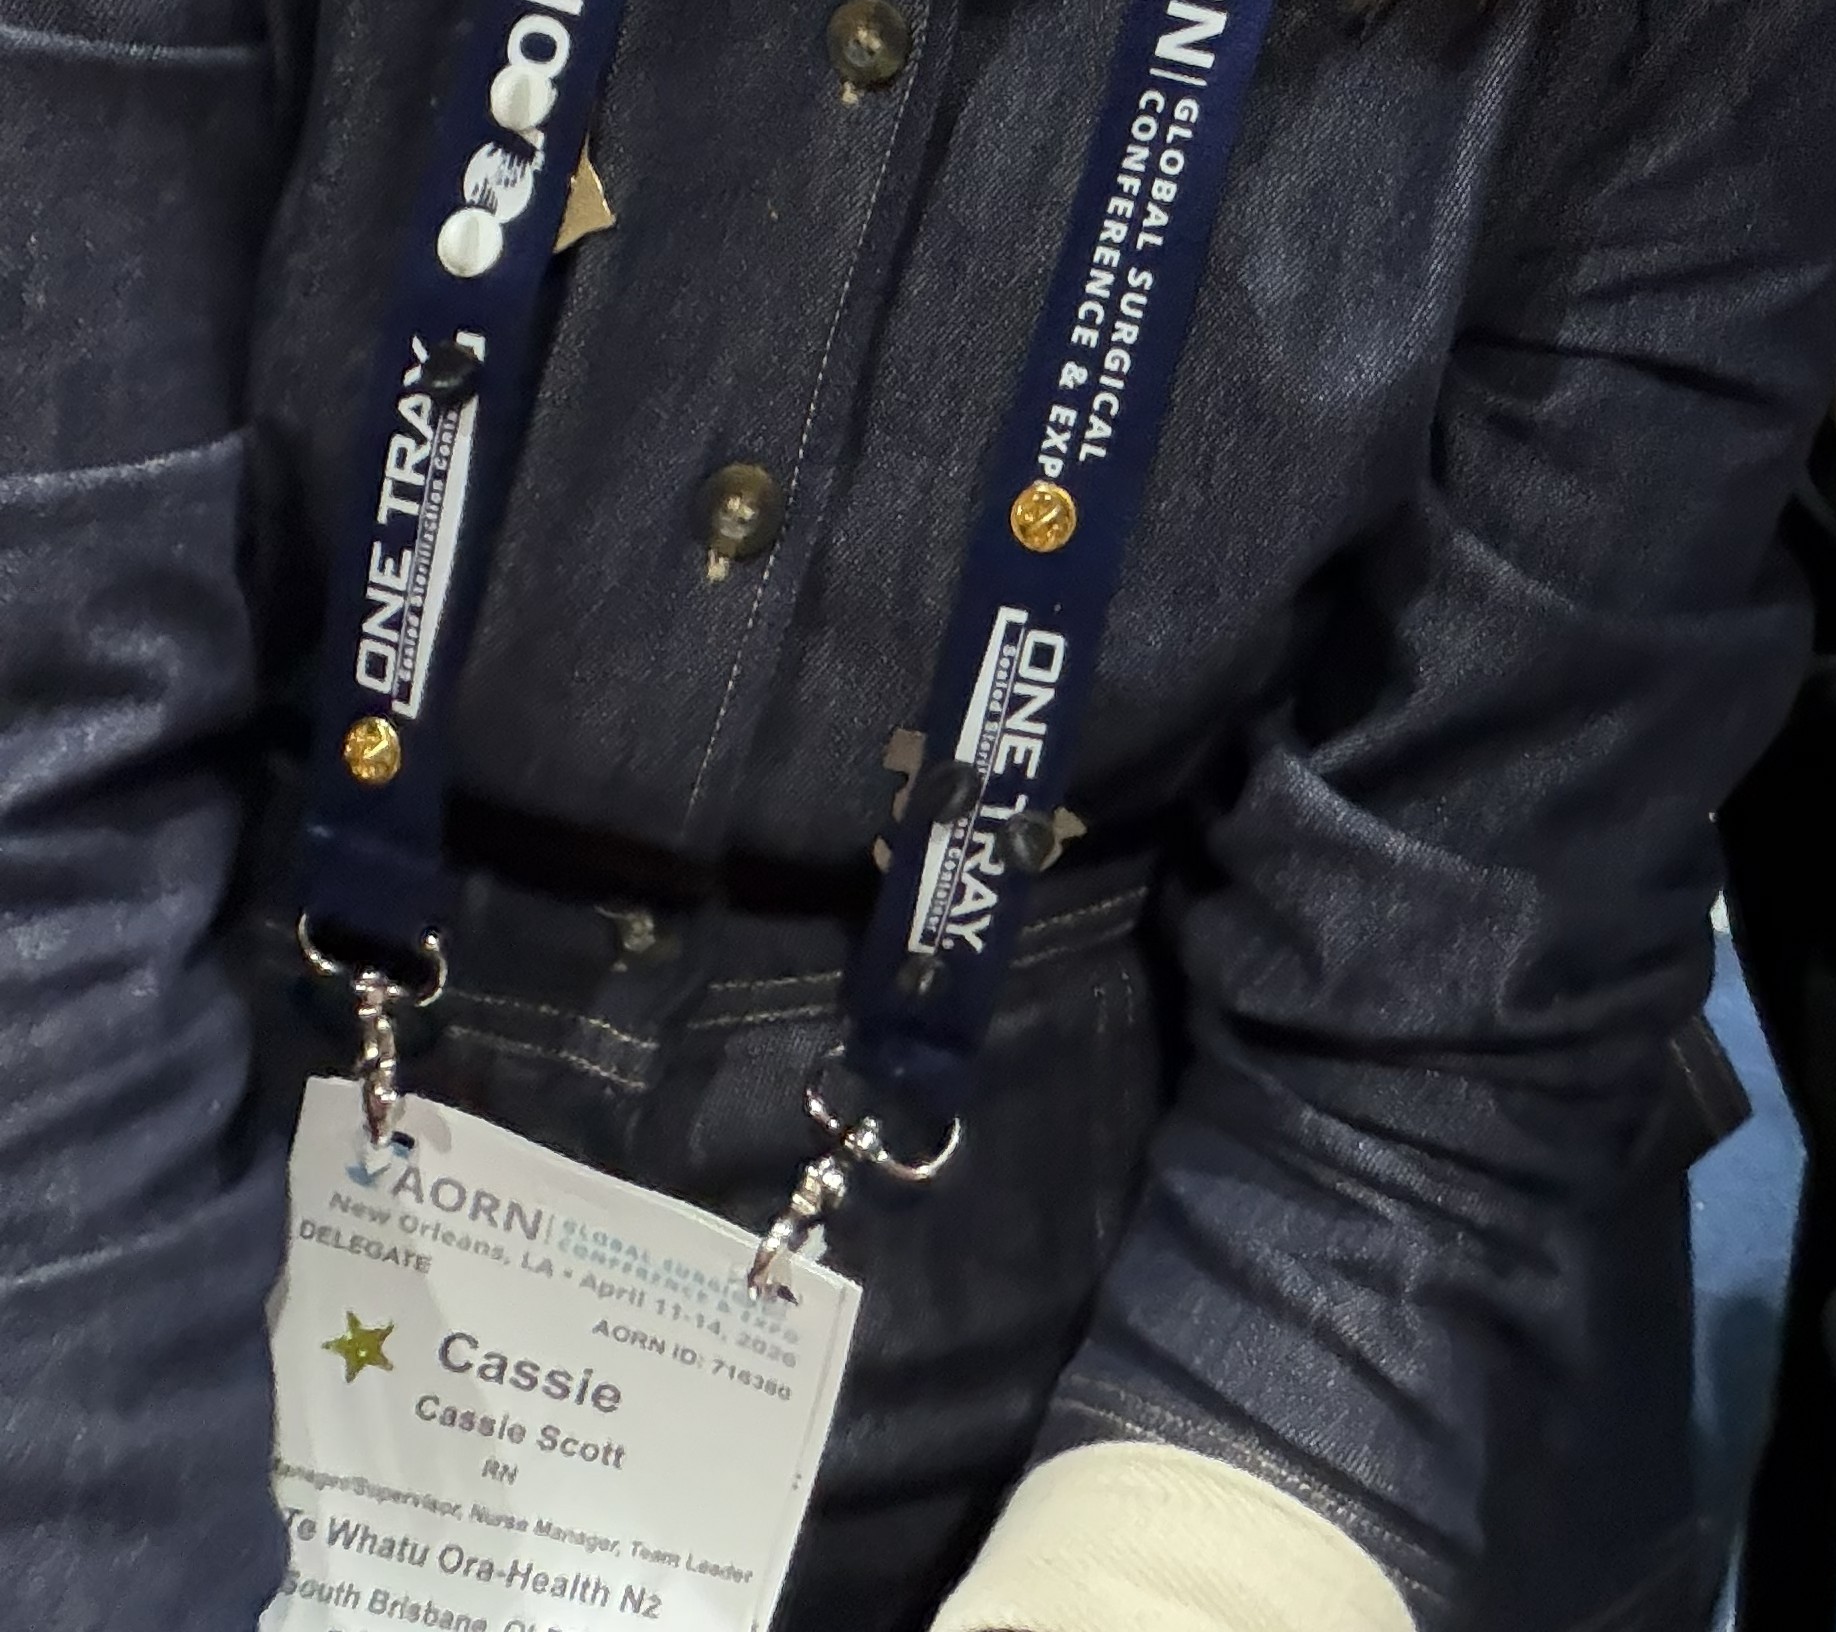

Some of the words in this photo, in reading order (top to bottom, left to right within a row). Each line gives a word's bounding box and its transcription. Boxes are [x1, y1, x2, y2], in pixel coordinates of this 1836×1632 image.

[1135, 95, 1200, 251] GLOBAL
[1069, 89, 1166, 349] CONFERENCE
[1057, 361, 1090, 389] &
[1078, 265, 1156, 464] SURGICAL
[1037, 402, 1077, 480] EXP
[355, 539, 413, 695] ONE
[994, 628, 1066, 780] ONE
[391, 1165, 543, 1241] AORN
[299, 1219, 433, 1275] DELEGATE
[329, 1191, 391, 1226] New
[399, 1214, 512, 1267] Orleans,
[520, 1250, 554, 1280] LA
[579, 1272, 646, 1309] April
[438, 1331, 622, 1414] Cassie
[592, 1319, 666, 1356] AORN
[415, 1393, 527, 1446] Cassie
[536, 1424, 626, 1470] Scott
[481, 1457, 519, 1486] RN
[280, 1570, 361, 1610] South
[326, 1515, 431, 1568] Whatu
[438, 1544, 611, 1608] Ora-Health
